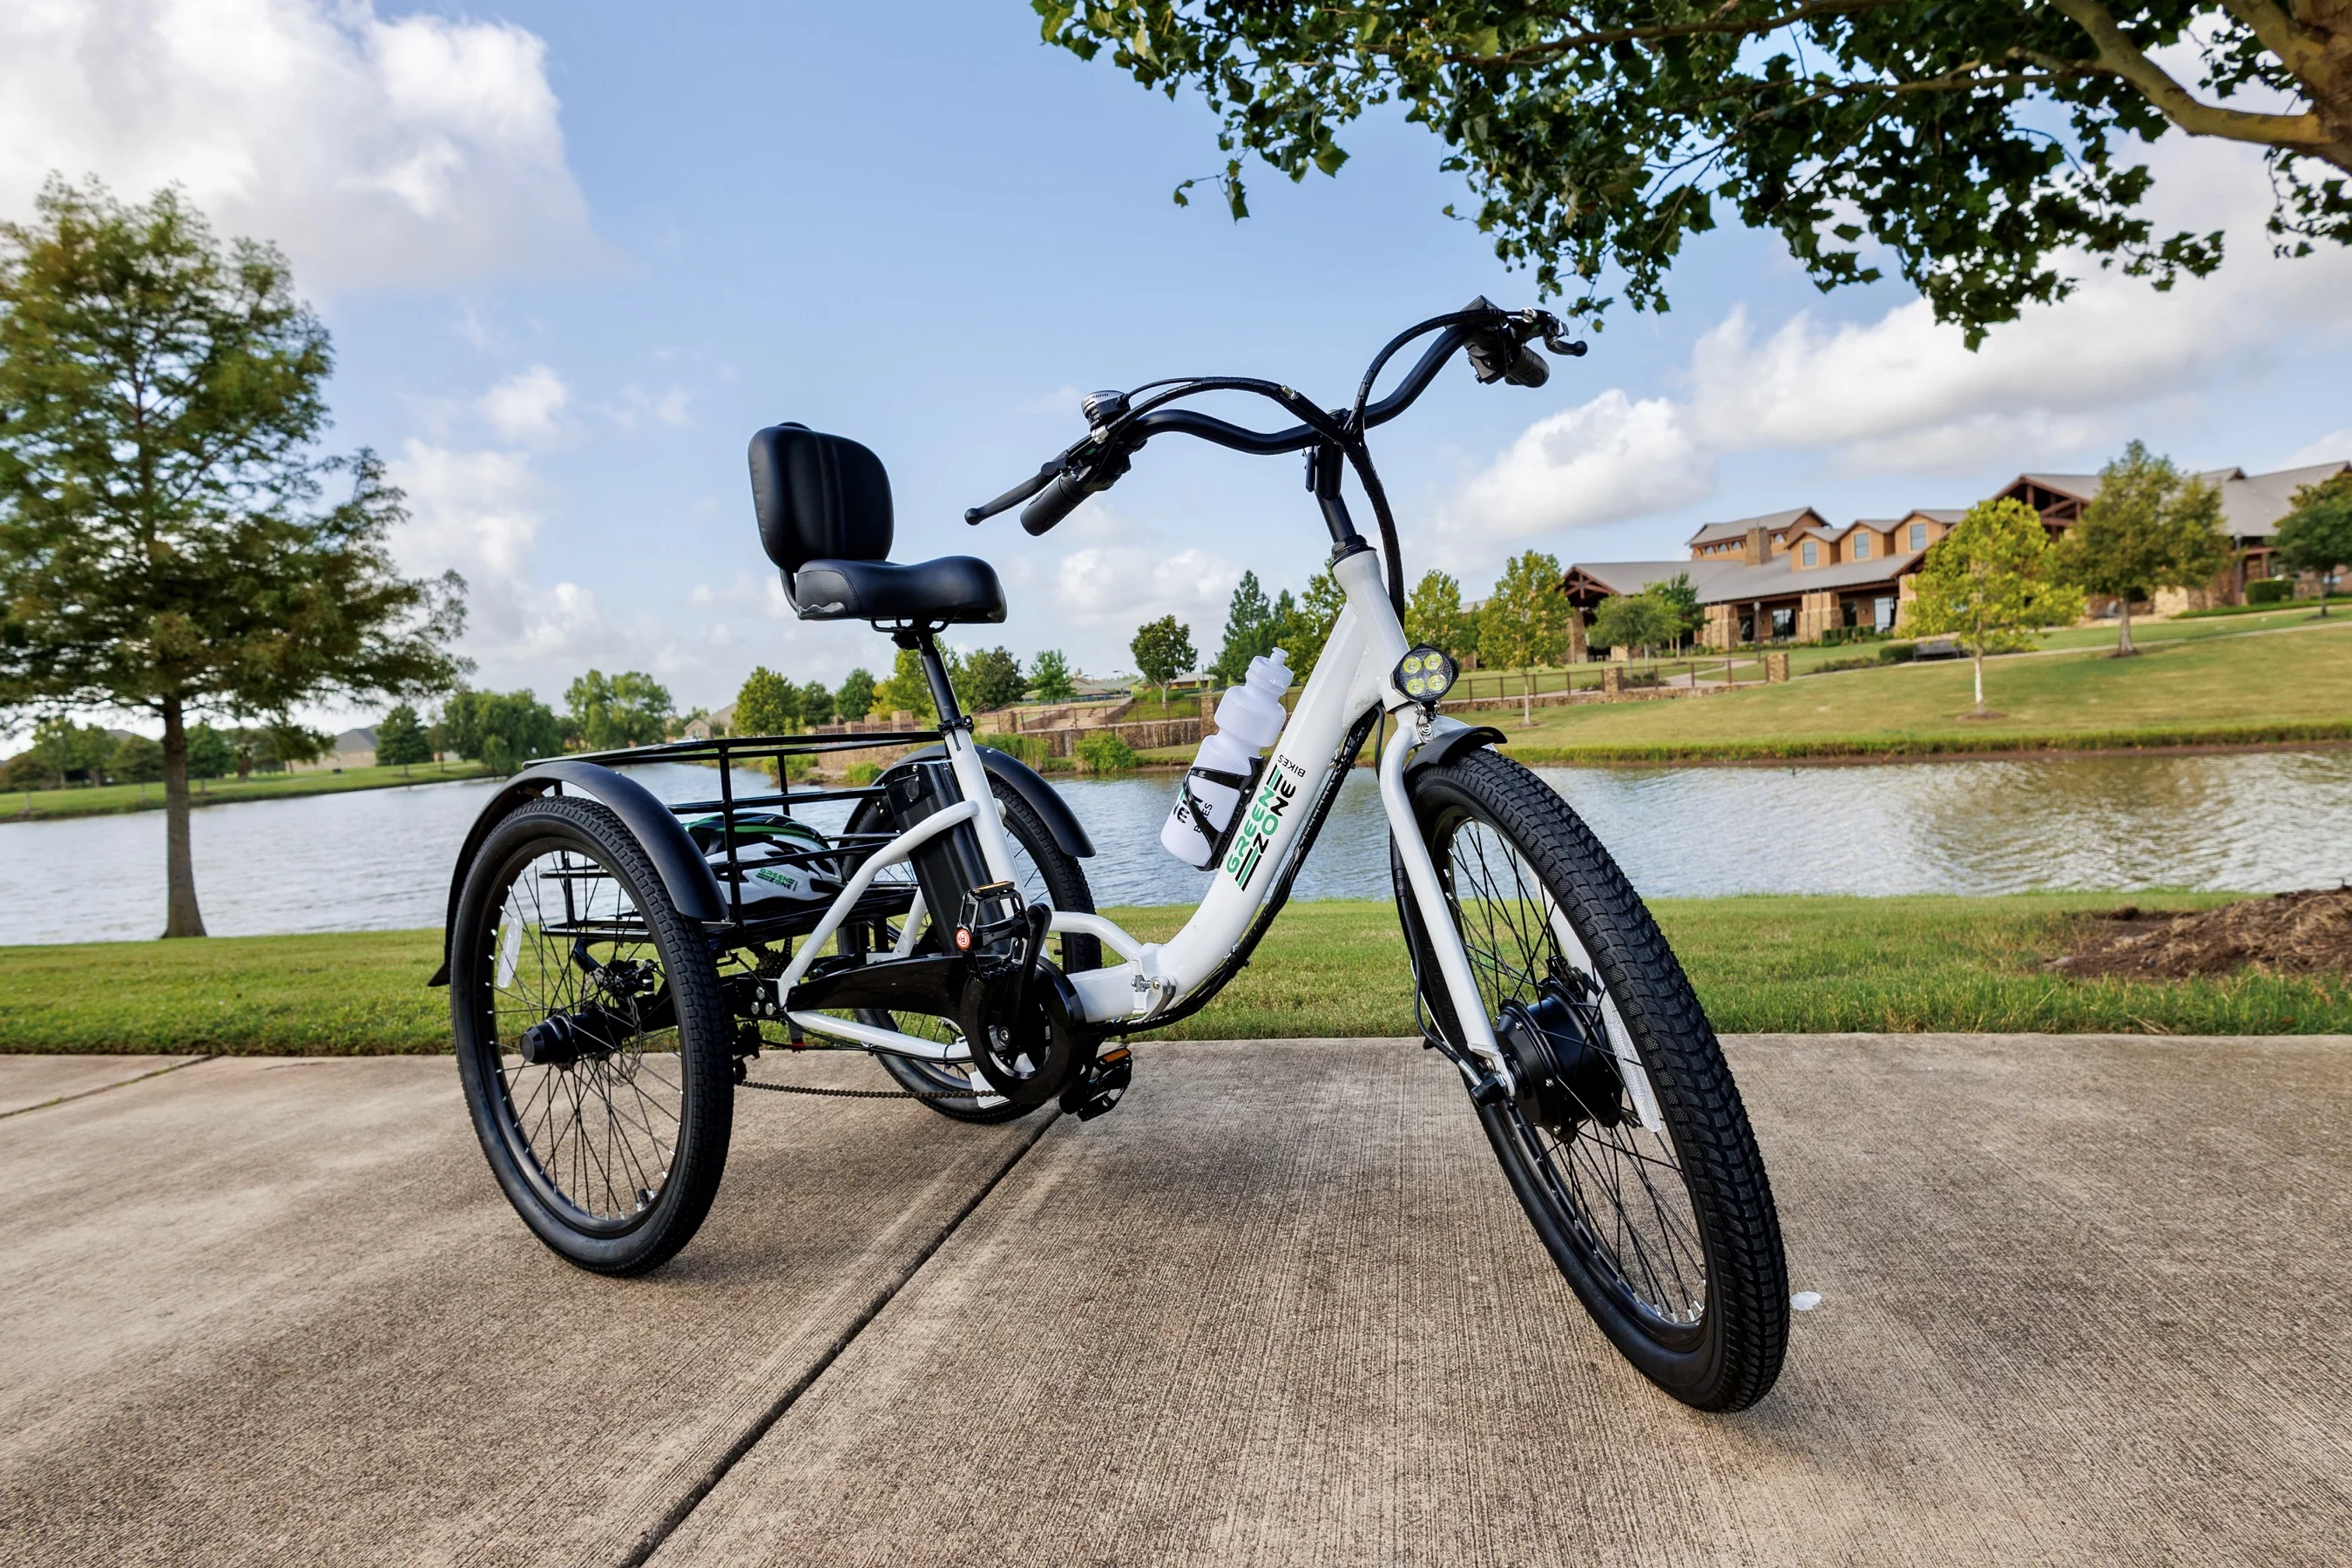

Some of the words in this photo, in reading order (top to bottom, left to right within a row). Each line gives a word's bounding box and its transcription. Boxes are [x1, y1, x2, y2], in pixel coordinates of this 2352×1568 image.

[1277, 754, 1307, 778] BIKES
[1193, 802, 1213, 834] BES
[1226, 786, 1275, 874] GREEN
[1252, 780, 1297, 855] ZONE
[760, 868, 789, 882] GREEN
